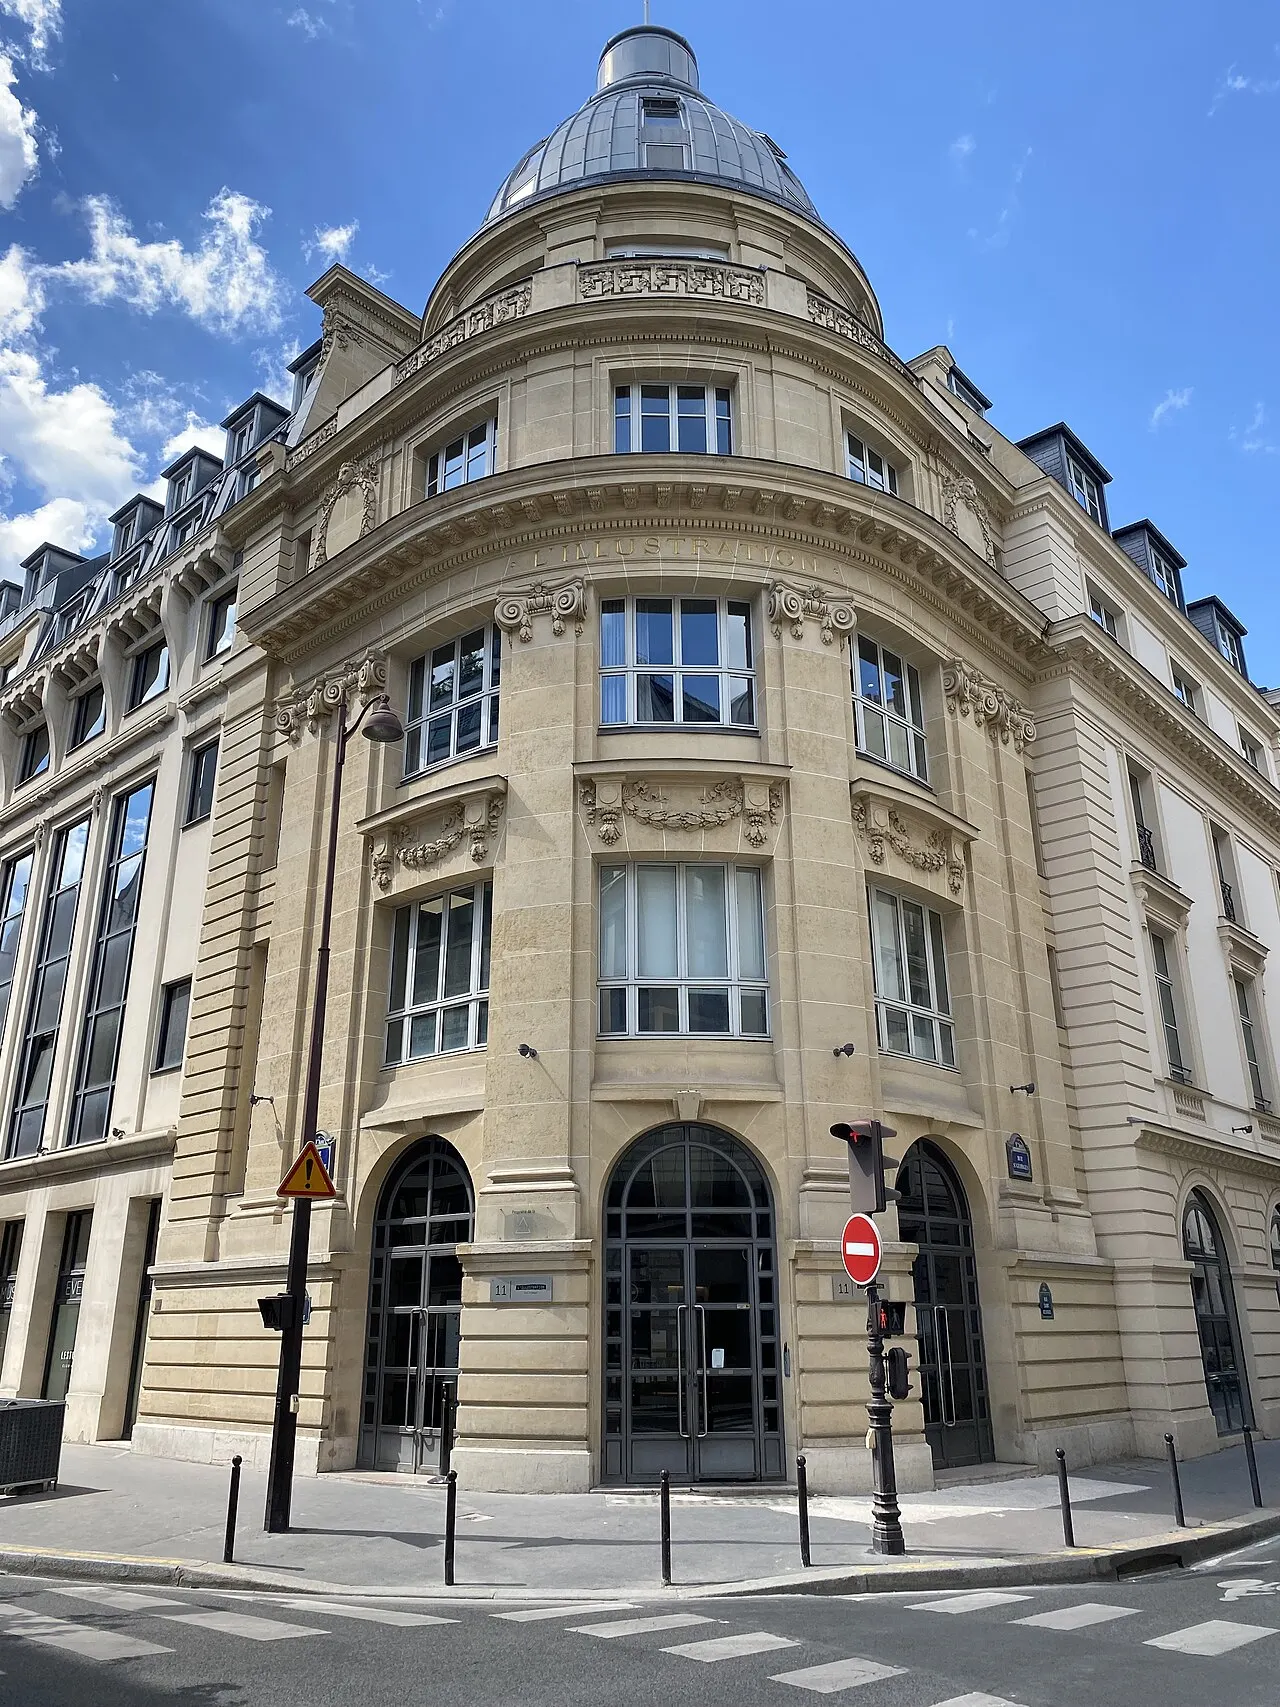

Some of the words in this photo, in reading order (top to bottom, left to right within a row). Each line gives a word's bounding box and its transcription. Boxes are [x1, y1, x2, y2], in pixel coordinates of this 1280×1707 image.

[533, 537, 818, 573] L'ILLUSTRATION
[495, 1284, 507, 1296] 11
[838, 1283, 849, 1294] 11
